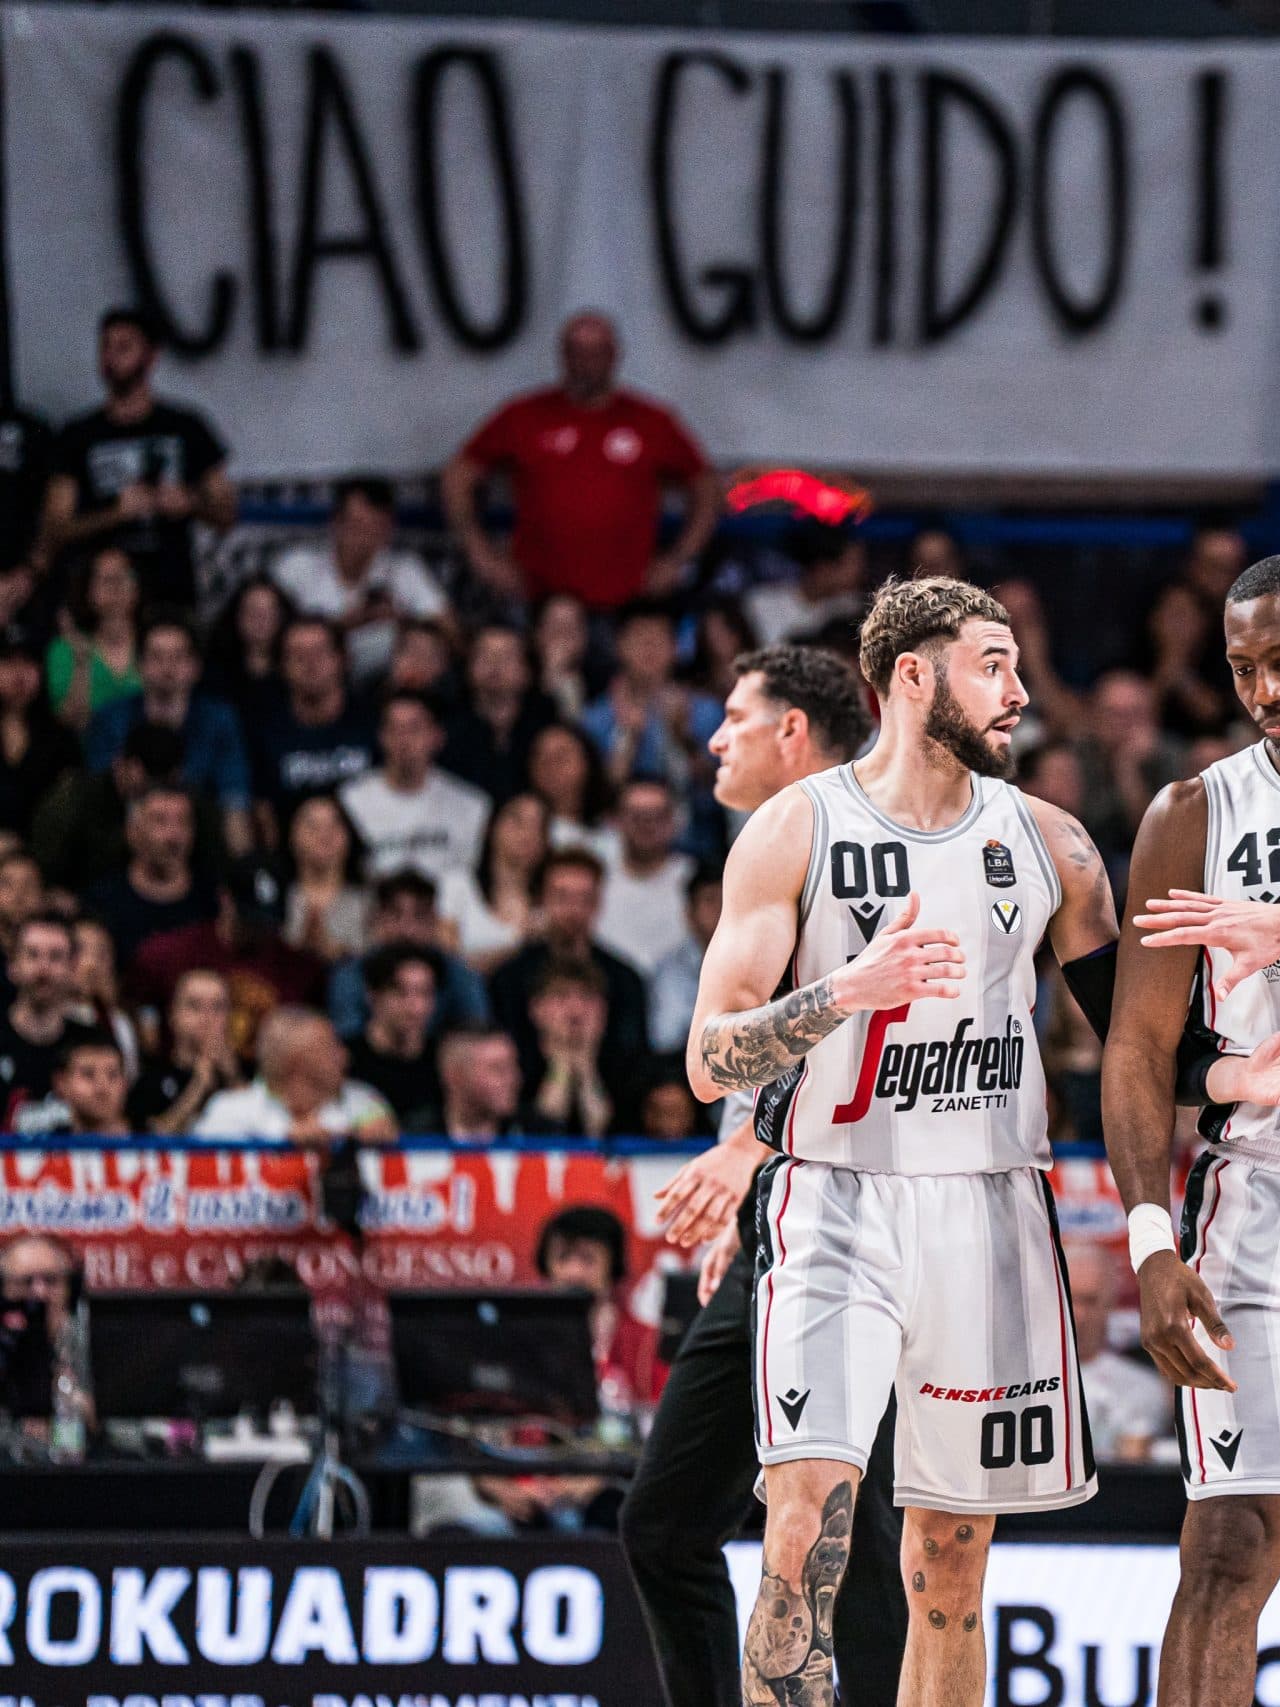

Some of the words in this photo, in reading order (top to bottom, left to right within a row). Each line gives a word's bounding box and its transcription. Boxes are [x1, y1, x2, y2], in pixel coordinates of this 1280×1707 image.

[113, 28, 528, 357] CIAO
[648, 50, 1131, 348] GUIDO
[831, 841, 910, 899] 00
[987, 858, 1010, 867] LBA
[931, 1094, 1007, 1113] ZANETTI
[919, 1376, 1061, 1403] PENSKECARS
[980, 1405, 1055, 1469] 00
[0, 1565, 603, 1666] OKUADRO
